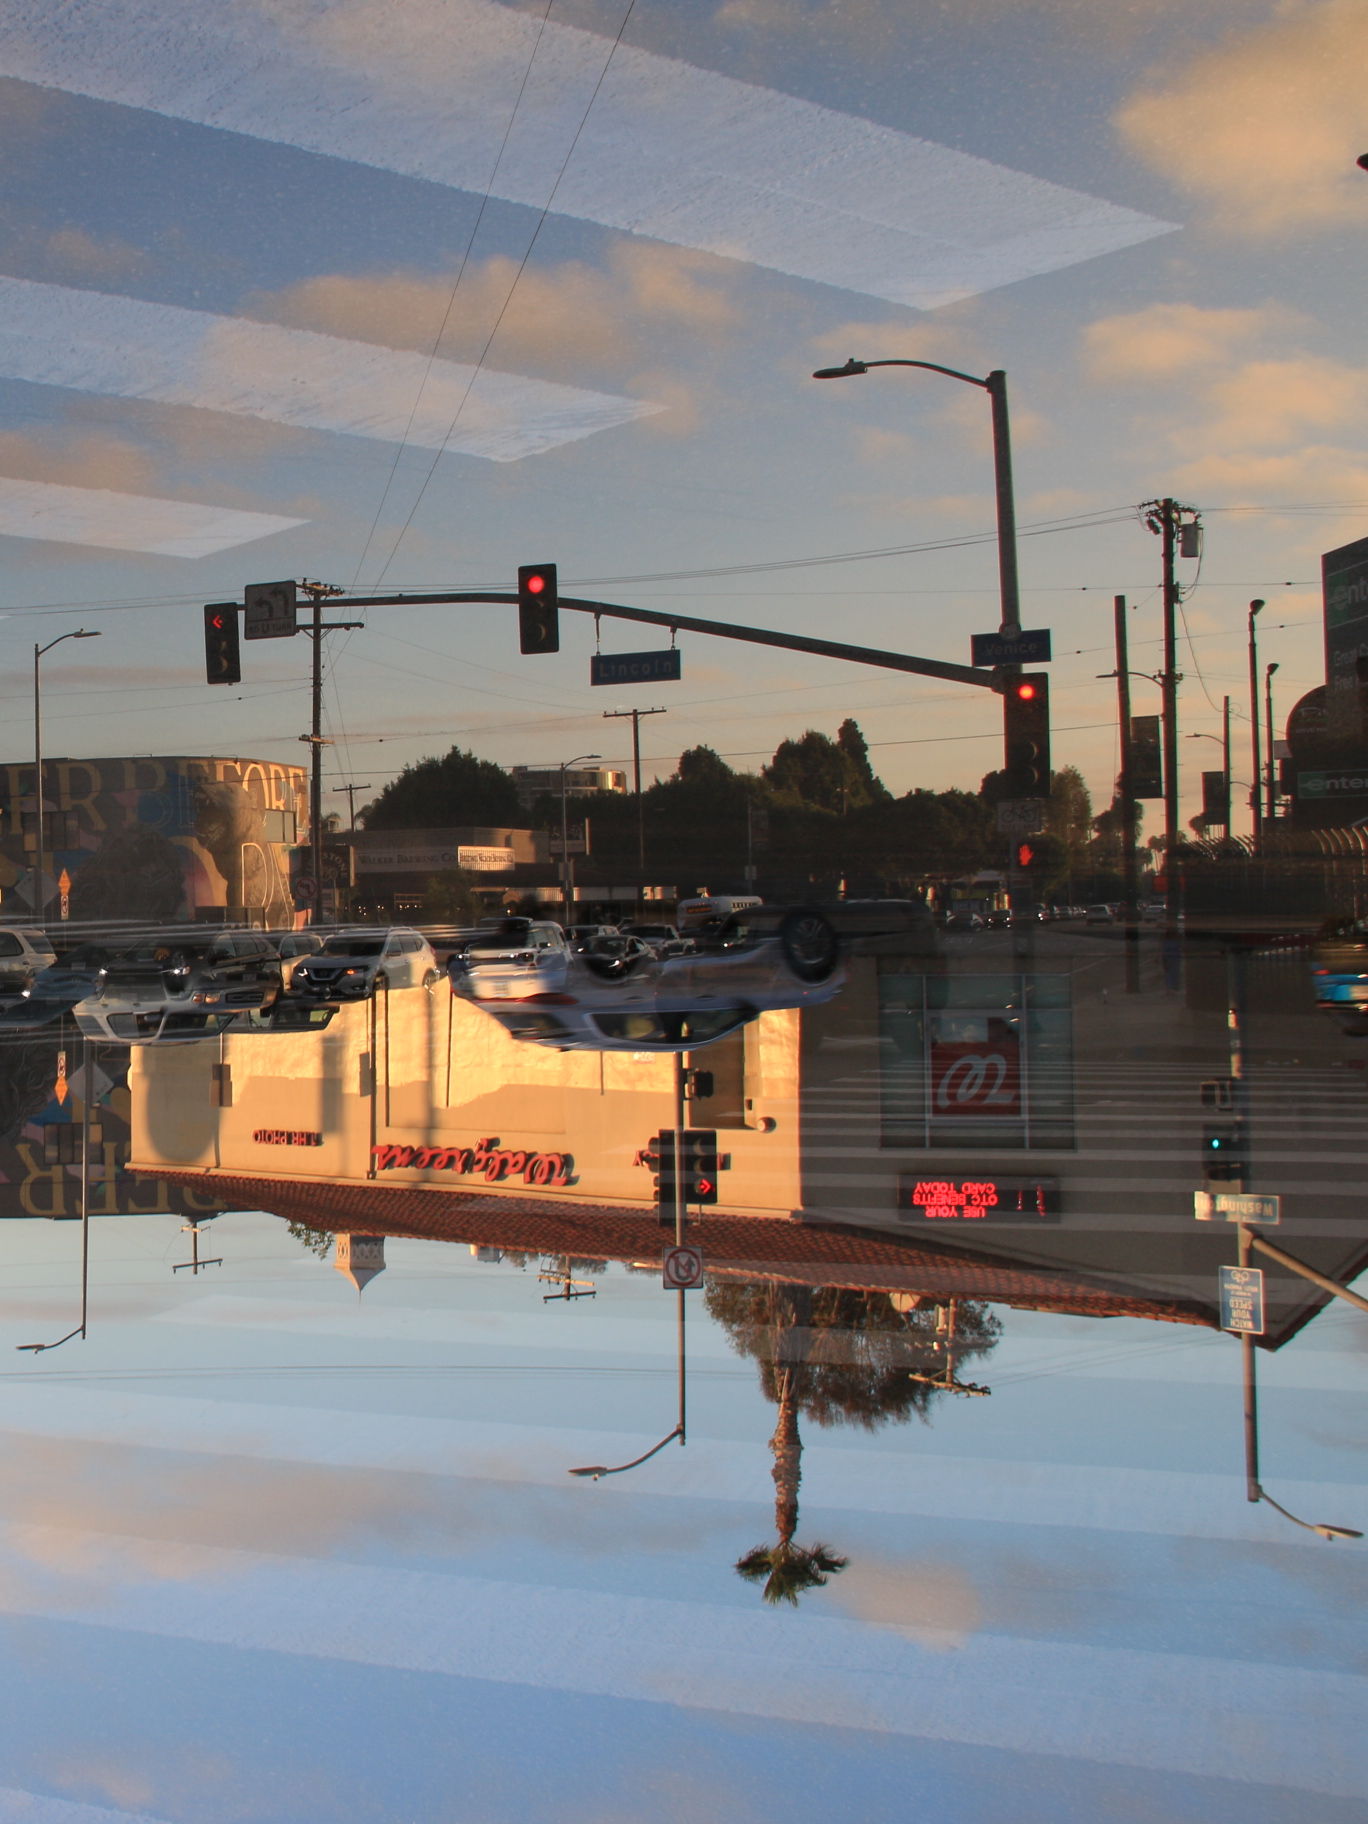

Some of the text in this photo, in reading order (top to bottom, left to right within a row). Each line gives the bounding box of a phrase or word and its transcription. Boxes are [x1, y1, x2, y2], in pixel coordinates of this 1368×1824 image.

[984, 641, 1038, 656] Venice
[598, 659, 673, 678] Lincoln
[252, 1130, 287, 1145] PHOTO
[290, 1132, 306, 1146] HR
[370, 1137, 572, 1187] Walgreens
[914, 1182, 996, 1194] CARD TODAY
[912, 1193, 999, 1206] OTC BENEFITS
[925, 1205, 986, 1218] USE YOUR
[1229, 1299, 1254, 1310] SPEED
[1231, 1309, 1252, 1320] YOUR
[1230, 1318, 1254, 1330] WATCH
